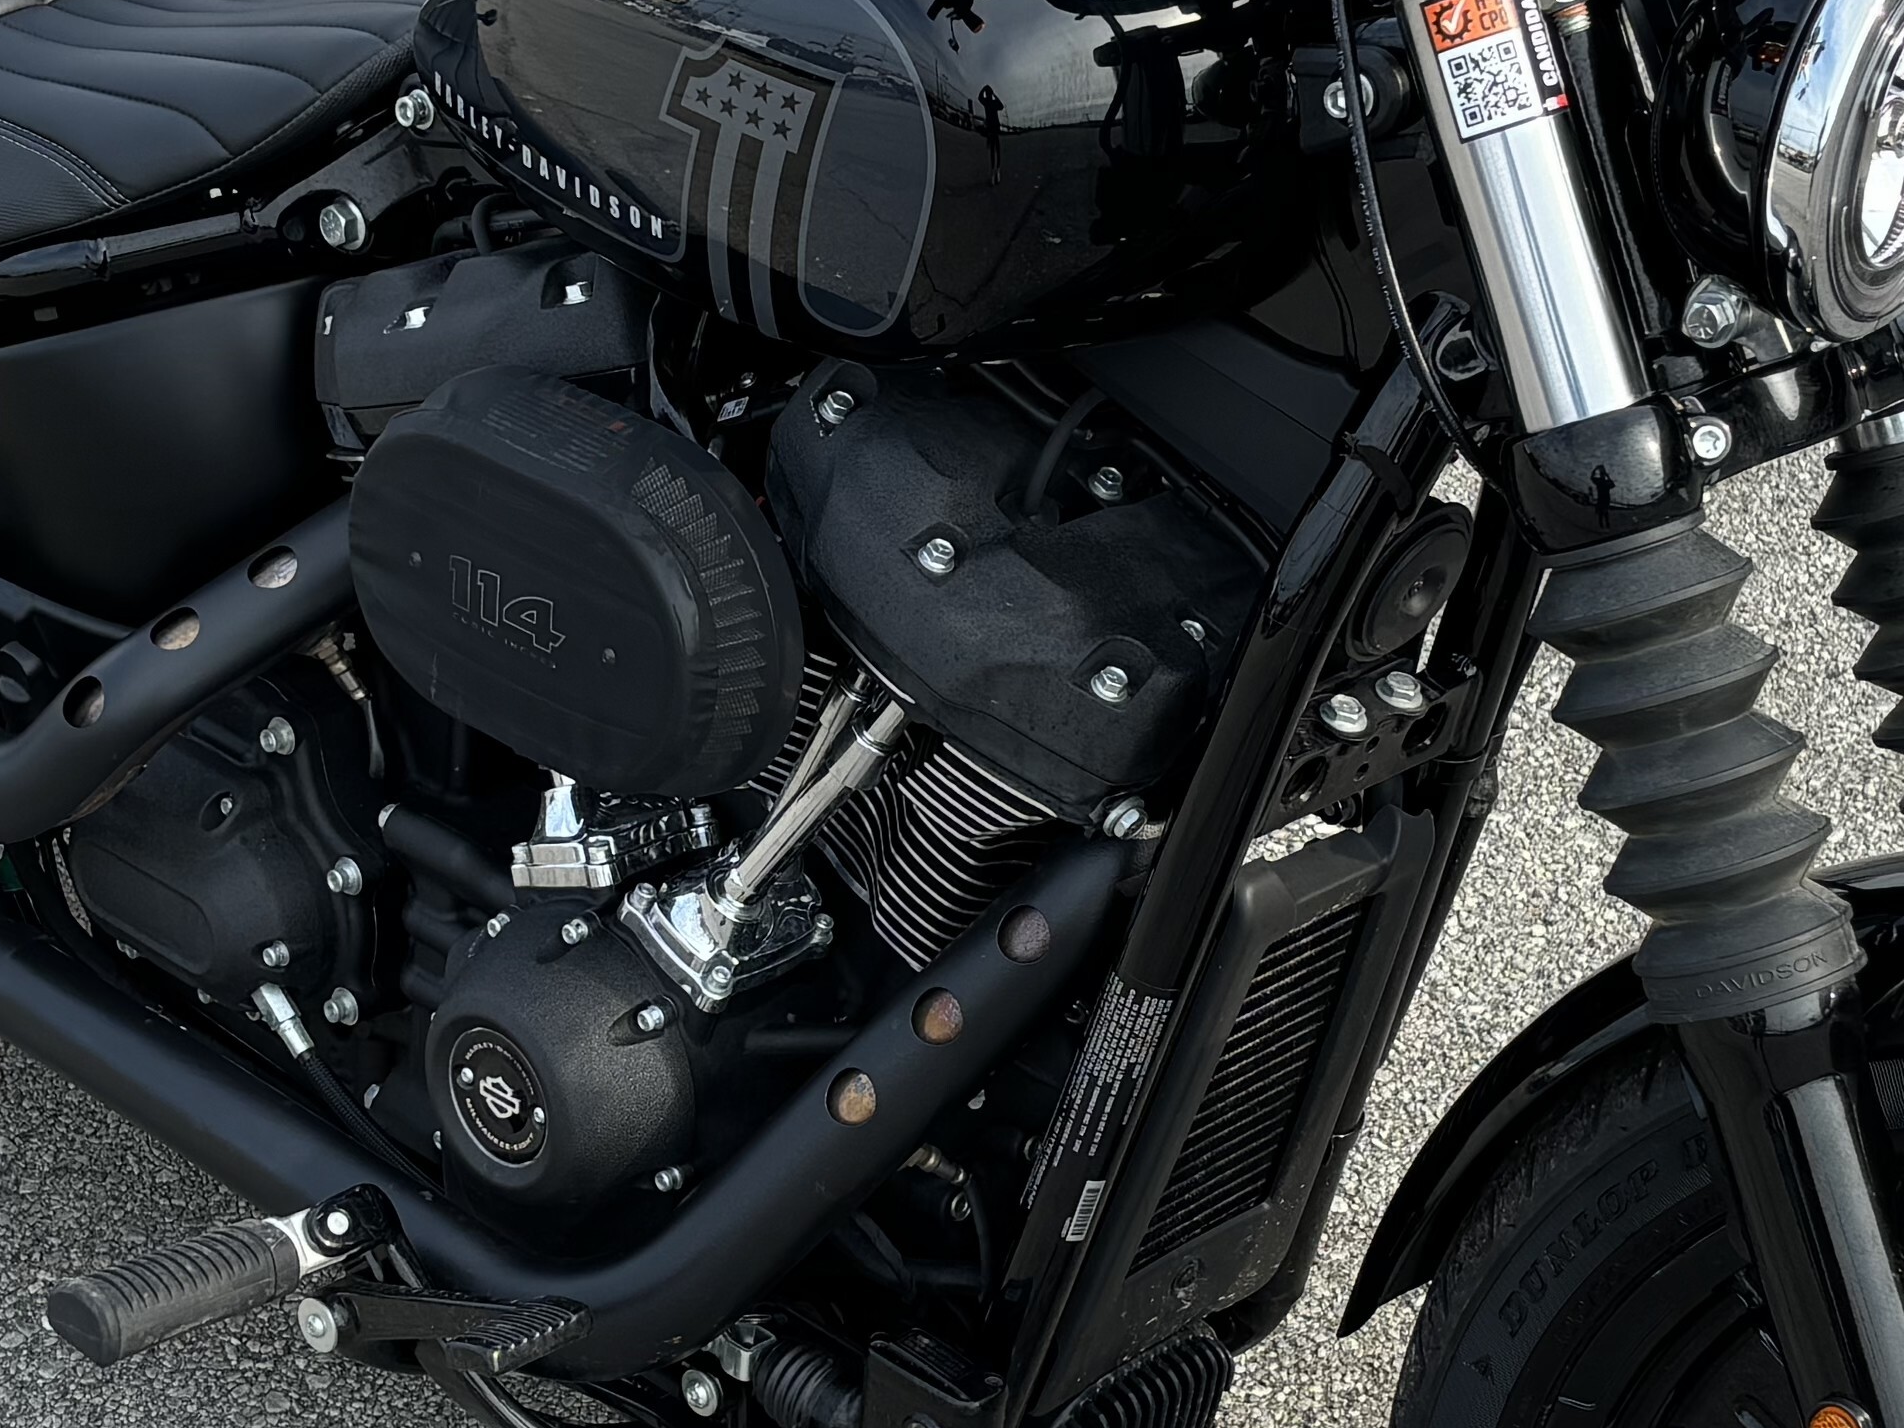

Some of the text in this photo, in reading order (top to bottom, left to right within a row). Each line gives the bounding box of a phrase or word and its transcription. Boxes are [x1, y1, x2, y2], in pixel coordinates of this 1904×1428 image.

[434, 70, 663, 239] HARLEY-DAVIDSON
[448, 554, 567, 654] 114
[1497, 1158, 1659, 1339] DUNLOP
